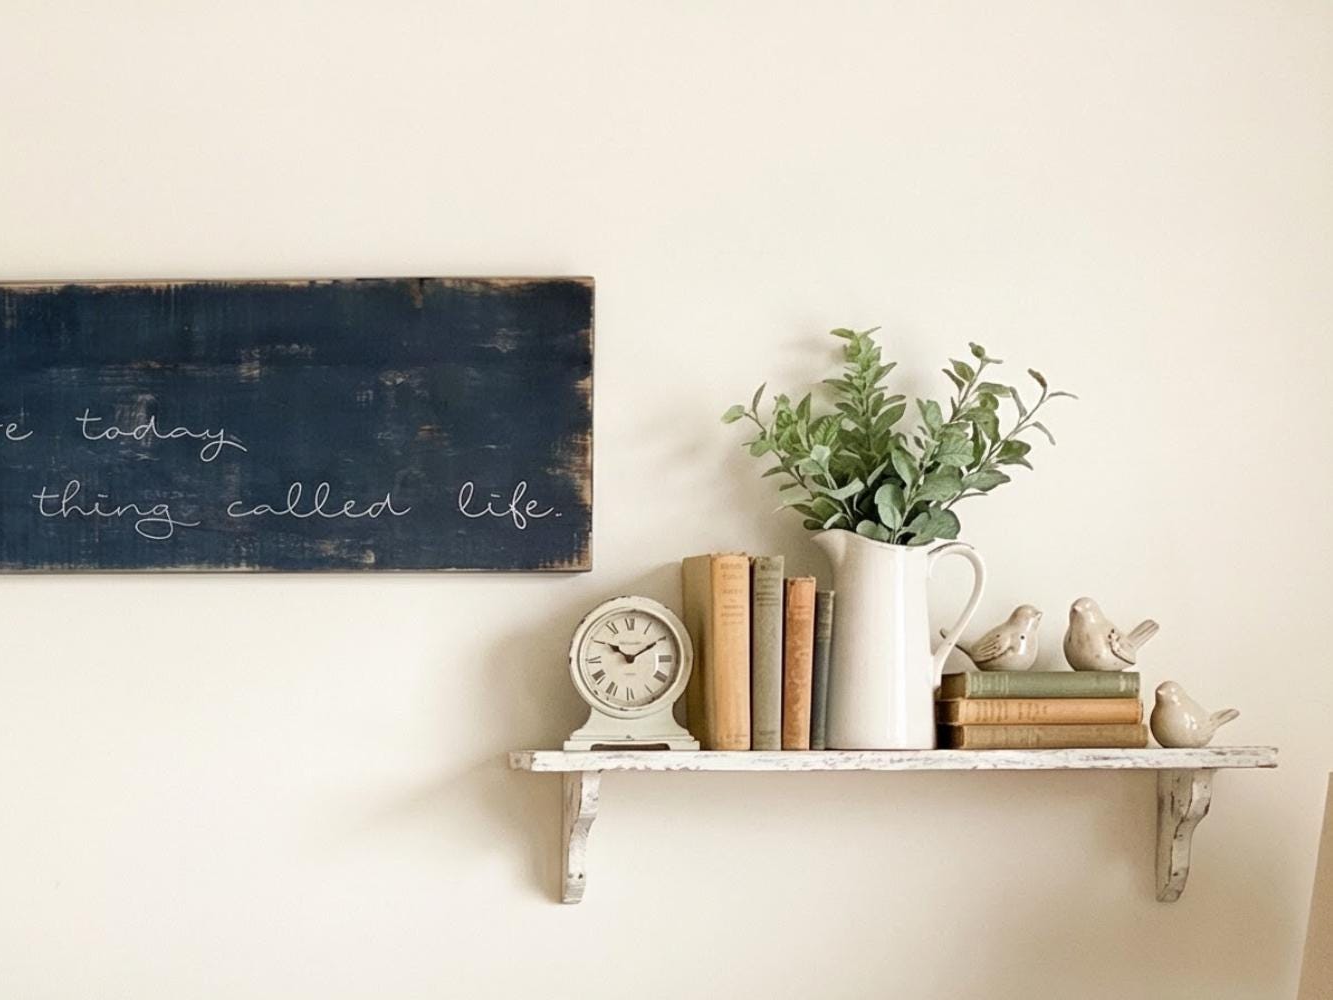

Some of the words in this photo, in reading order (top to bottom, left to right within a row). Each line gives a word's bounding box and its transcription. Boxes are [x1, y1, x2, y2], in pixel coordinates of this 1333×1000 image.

[75, 408, 248, 462] today
[32, 479, 200, 540] thing
[227, 482, 411, 518] called
[457, 481, 563, 530] life.
